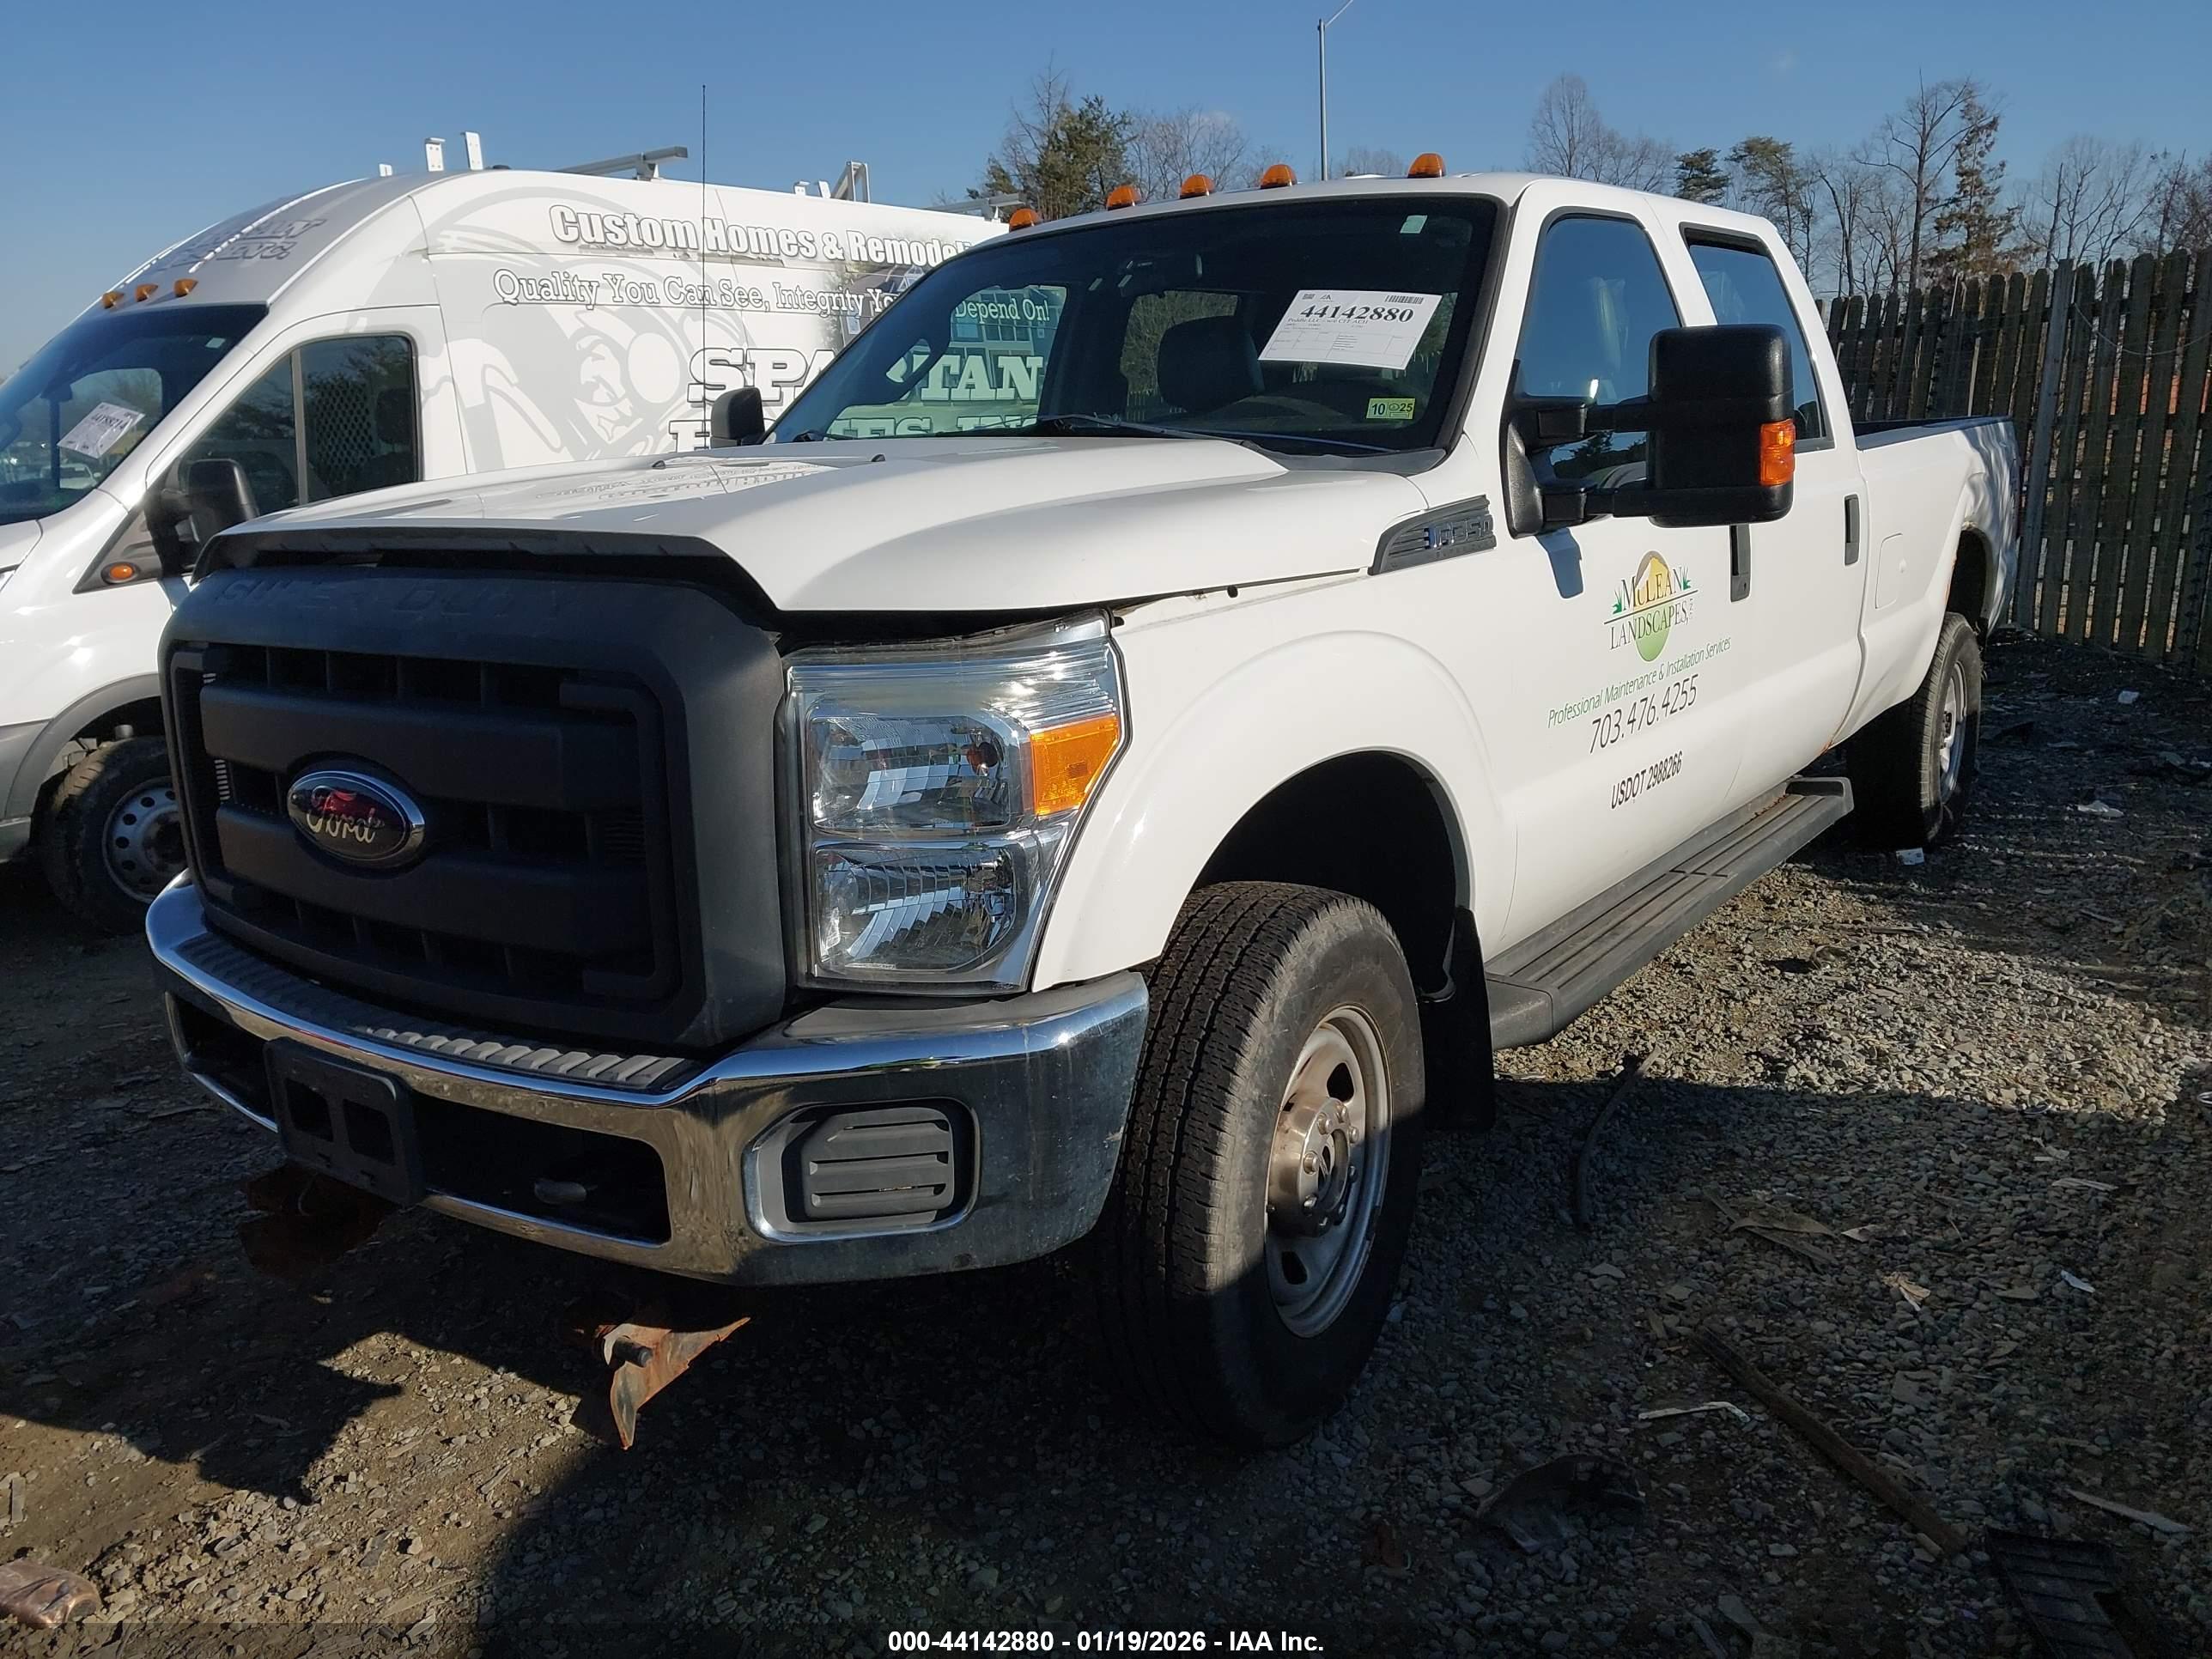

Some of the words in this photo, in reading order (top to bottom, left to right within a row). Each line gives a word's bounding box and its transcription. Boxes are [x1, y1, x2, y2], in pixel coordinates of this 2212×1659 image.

[549, 204, 699, 250] Custom
[702, 217, 817, 258] Homes
[822, 232, 845, 261] &
[846, 229, 973, 268] Remod
[494, 268, 599, 310] Quality
[603, 274, 660, 303] You
[664, 276, 716, 307] Can
[719, 279, 770, 313] See,
[773, 282, 865, 319] Integrity
[866, 288, 899, 313] Yo
[954, 297, 1020, 325] Depend
[1022, 297, 1050, 322] On!
[1301, 304, 1414, 323] 44142880
[687, 347, 1043, 404] SPTAN
[1372, 403, 1386, 416] 10
[1400, 403, 1413, 412] 25
[1610, 600, 1689, 650] LANDSCAPES,
[1547, 689, 1604, 728] Professional
[1604, 669, 1657, 704] Maintenance
[1658, 663, 1665, 681] &
[1666, 650, 1705, 678] Installation
[1705, 636, 1731, 660] Services
[1589, 673, 1698, 754] 703.476.4255
[1611, 769, 1646, 810] USDOT
[1646, 750, 1683, 791] 2988266
[306, 785, 386, 844] Ford
